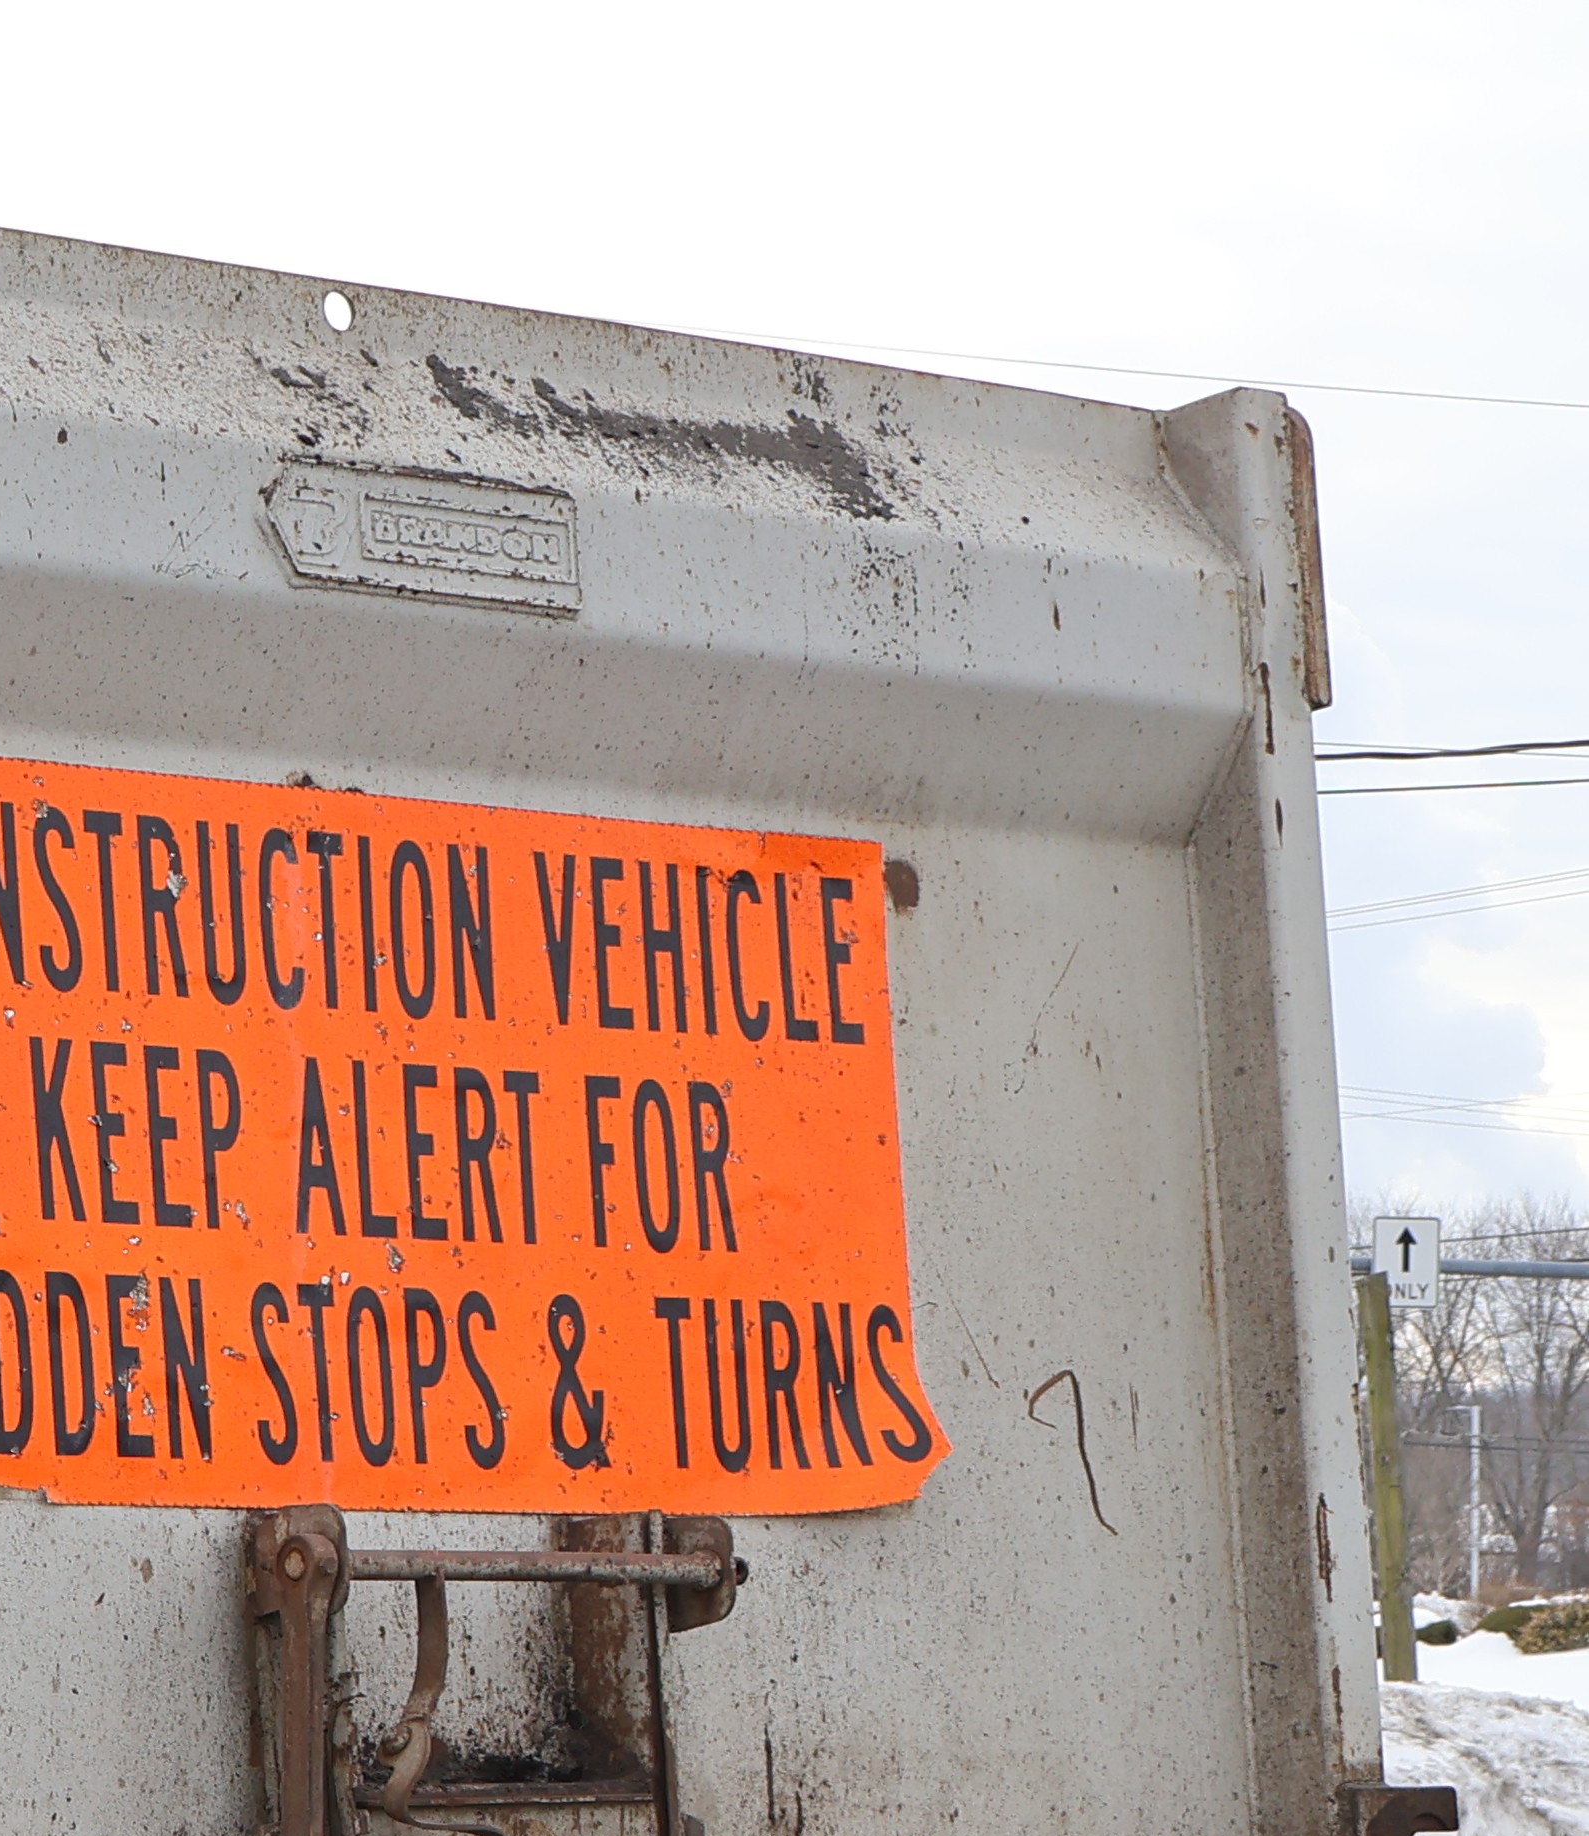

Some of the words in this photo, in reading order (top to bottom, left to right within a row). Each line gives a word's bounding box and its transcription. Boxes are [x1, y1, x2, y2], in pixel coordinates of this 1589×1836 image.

[370, 509, 561, 565] BRANDON
[534, 852, 863, 1044] VEHICLE
[30, 1037, 241, 1228] KEEP
[297, 1058, 539, 1244] ALERT
[585, 1076, 736, 1253] FOR
[251, 1282, 505, 1469] STOPS
[548, 1294, 610, 1469] &
[655, 1297, 932, 1472] TURNS
[1388, 1283, 1429, 1300] NLY
